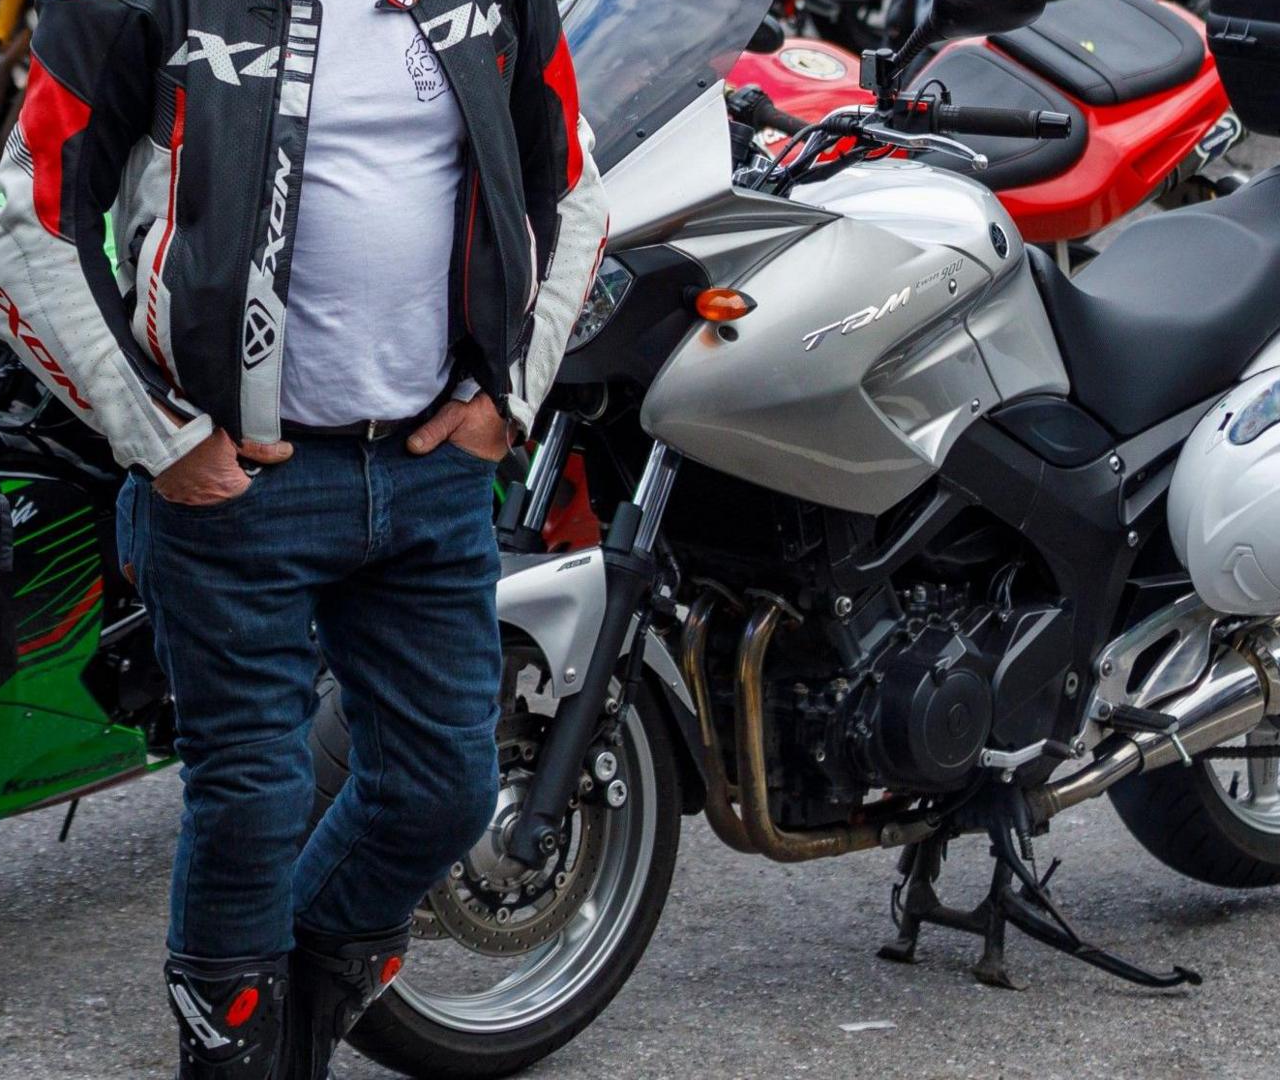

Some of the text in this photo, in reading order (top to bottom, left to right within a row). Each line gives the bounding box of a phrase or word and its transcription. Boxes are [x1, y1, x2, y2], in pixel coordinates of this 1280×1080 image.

[262, 147, 293, 277] IXON
[802, 285, 912, 353] TDM
[940, 257, 965, 283] 900
